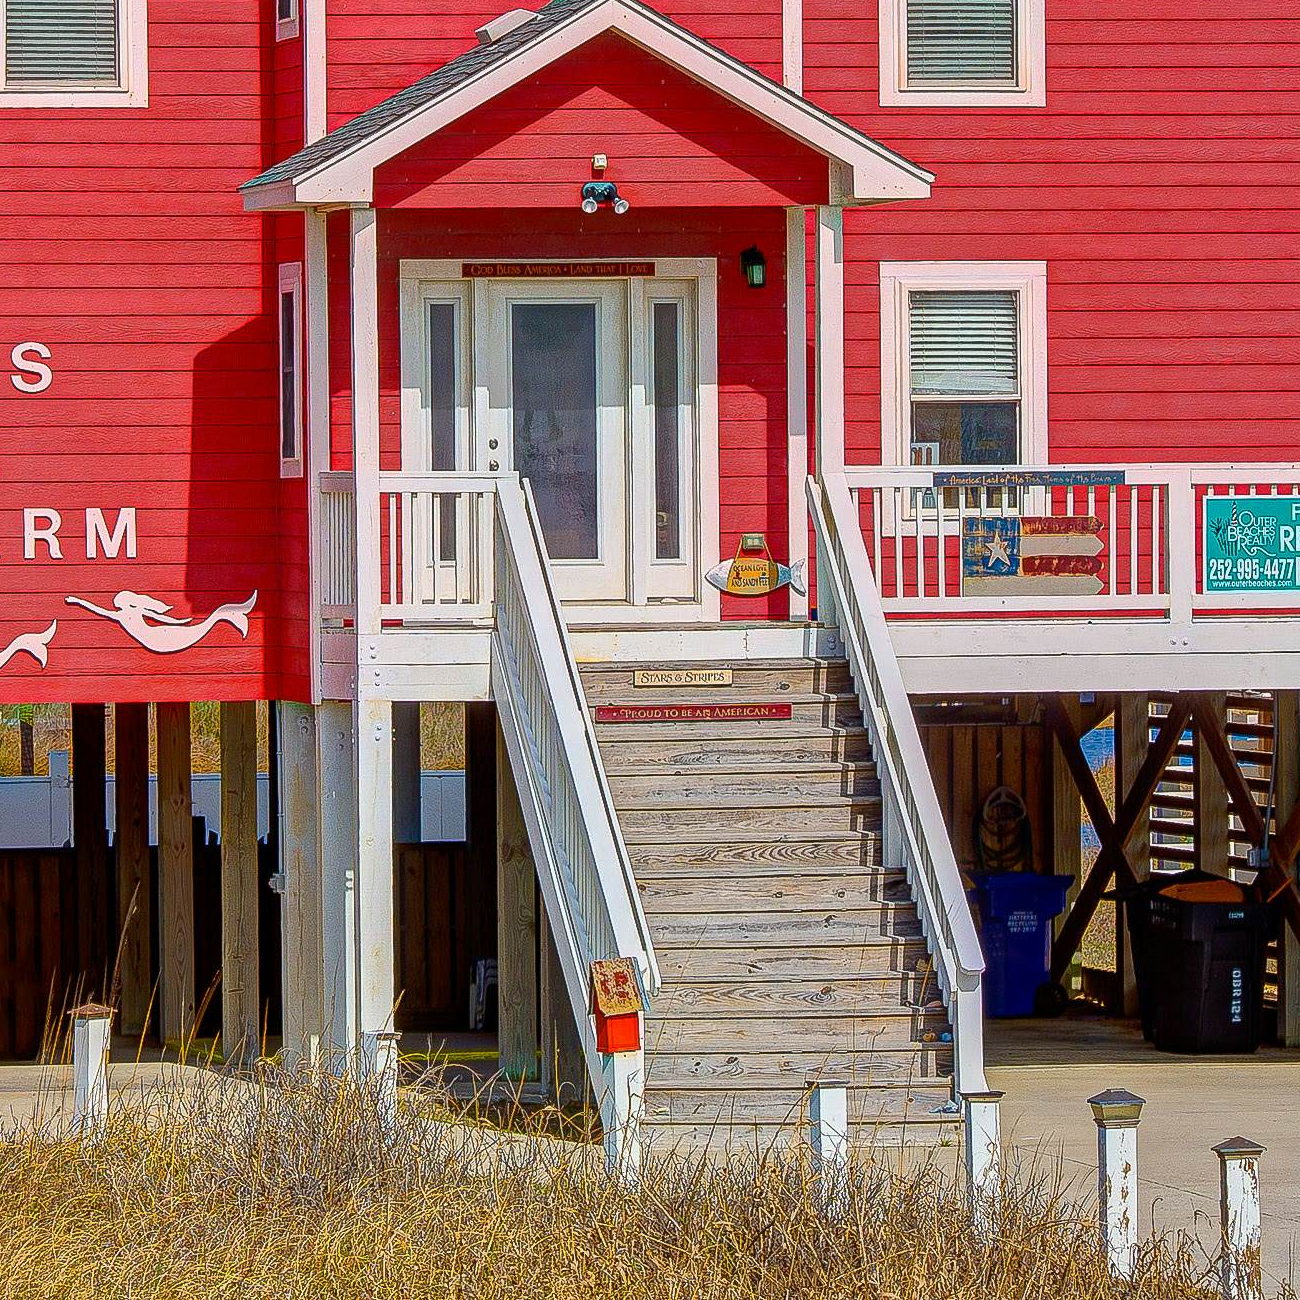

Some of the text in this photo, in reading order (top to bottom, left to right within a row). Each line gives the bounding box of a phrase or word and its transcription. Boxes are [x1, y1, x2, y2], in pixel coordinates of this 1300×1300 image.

[1238, 510, 1278, 527] OUTER
[1227, 526, 1276, 542] BEACHES
[1237, 536, 1276, 551] REALTY
[1209, 558, 1294, 580] 252-995-4477
[1212, 580, 1293, 588] www.outerbeaches.com
[1232, 970, 1242, 997] OBR
